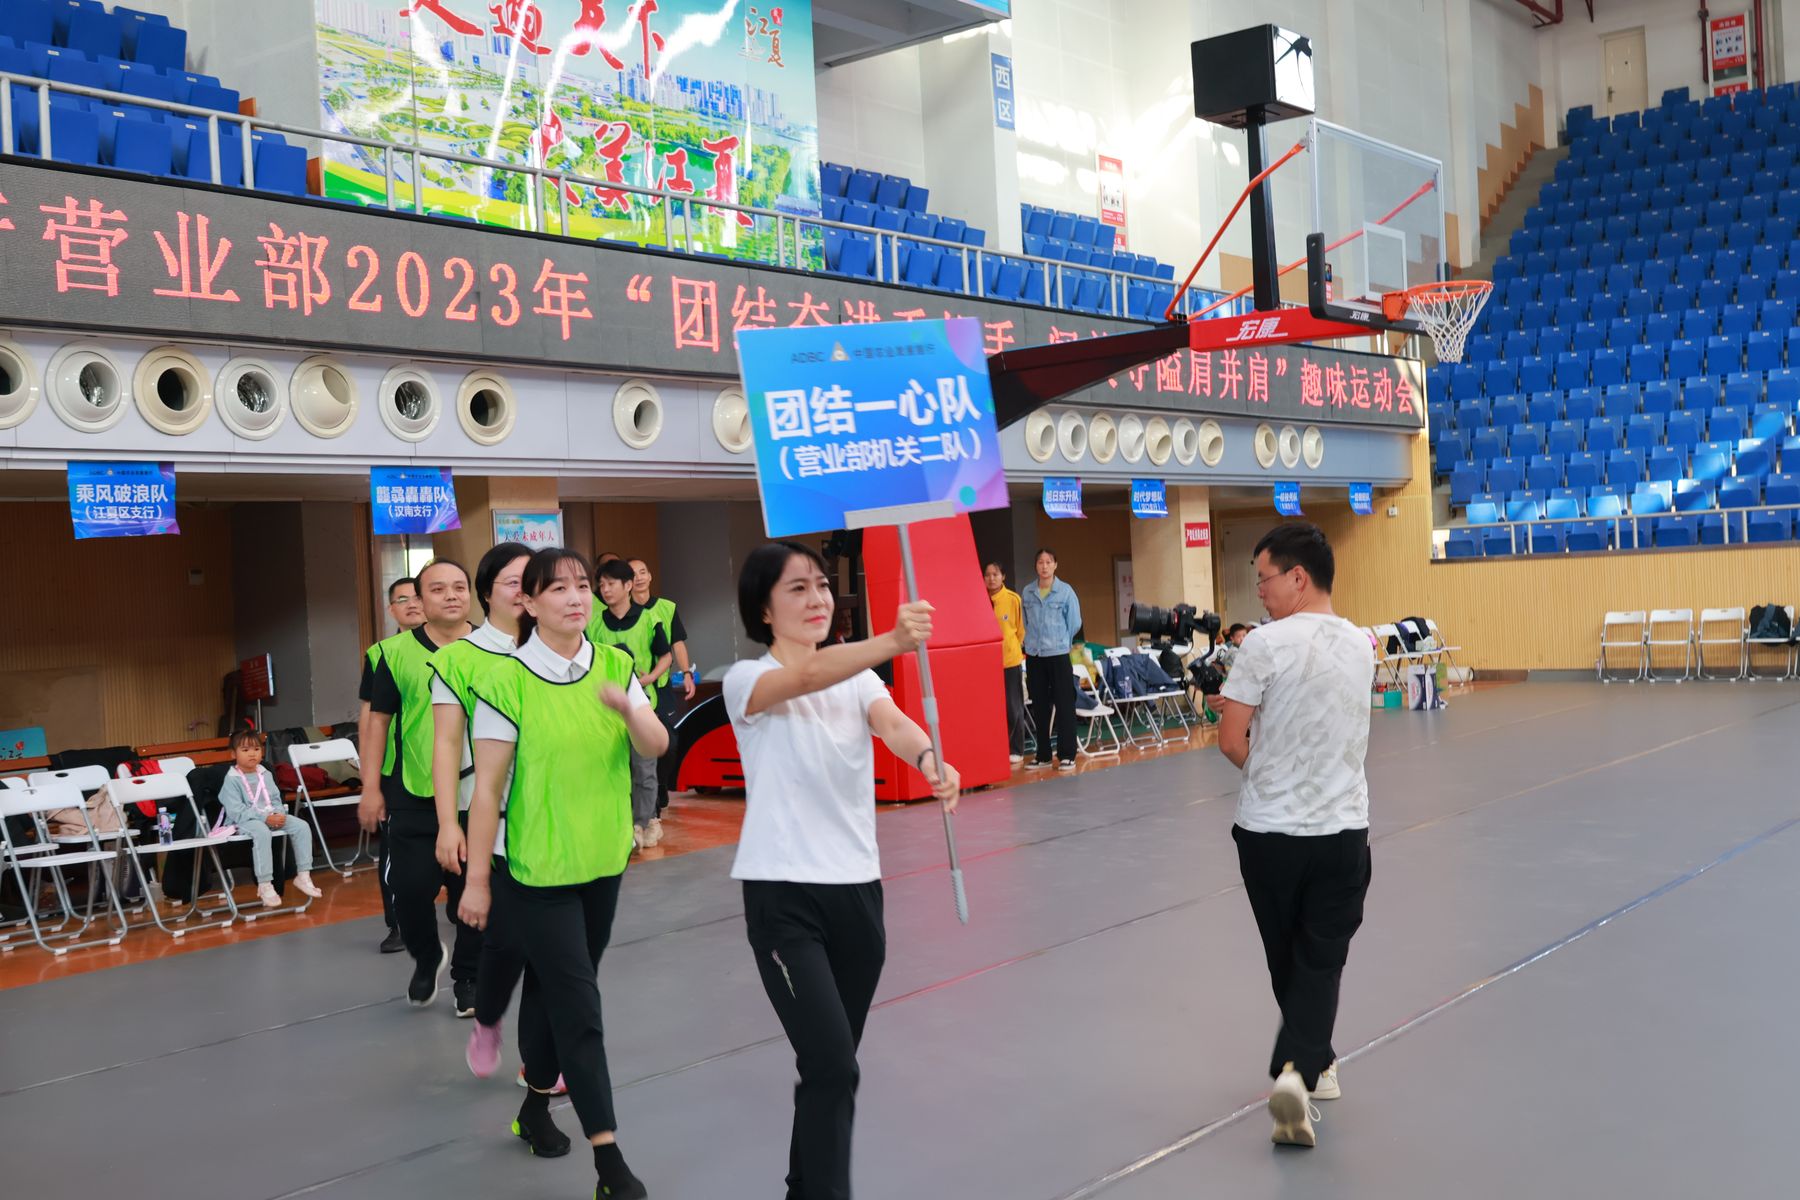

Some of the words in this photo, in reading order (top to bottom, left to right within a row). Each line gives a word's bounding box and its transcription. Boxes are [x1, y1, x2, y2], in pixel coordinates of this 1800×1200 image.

[994, 64, 1012, 122] 西区
[764, 374, 982, 440] 团结一心队
[76, 484, 168, 503] 乘风破浪队
